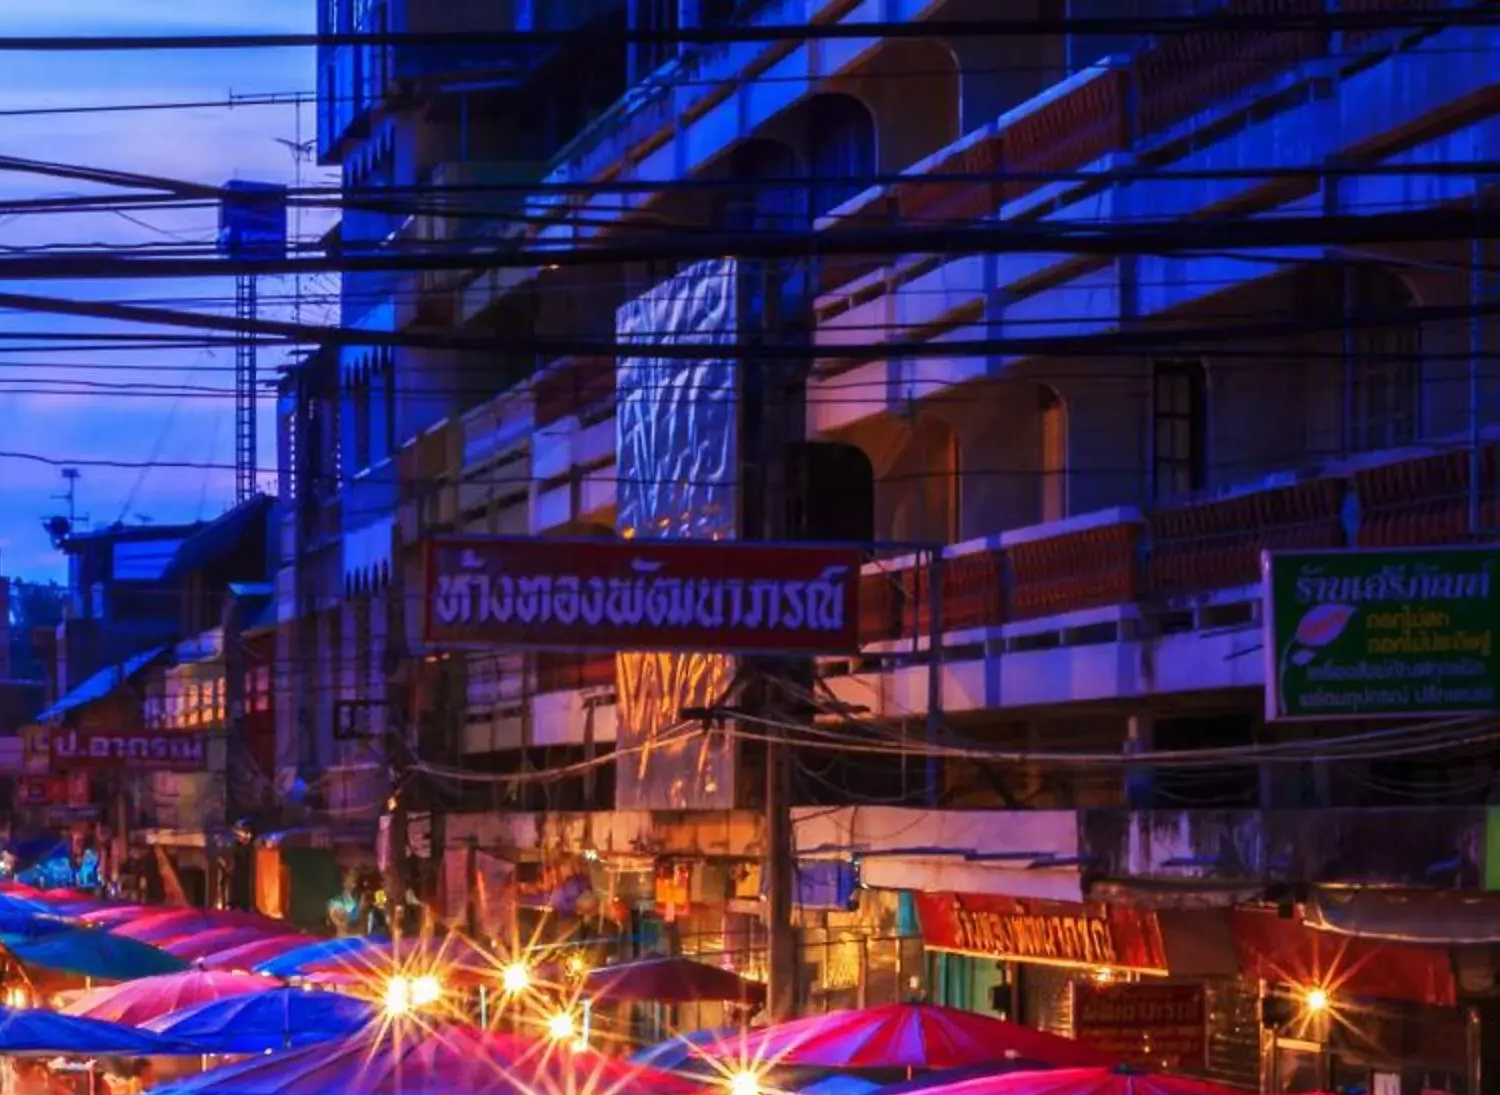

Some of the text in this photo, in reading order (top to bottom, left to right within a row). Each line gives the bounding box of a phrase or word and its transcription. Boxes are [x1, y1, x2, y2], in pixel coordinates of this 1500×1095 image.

[435, 548, 849, 631] ห้างทองพัฒนาภรณ์
